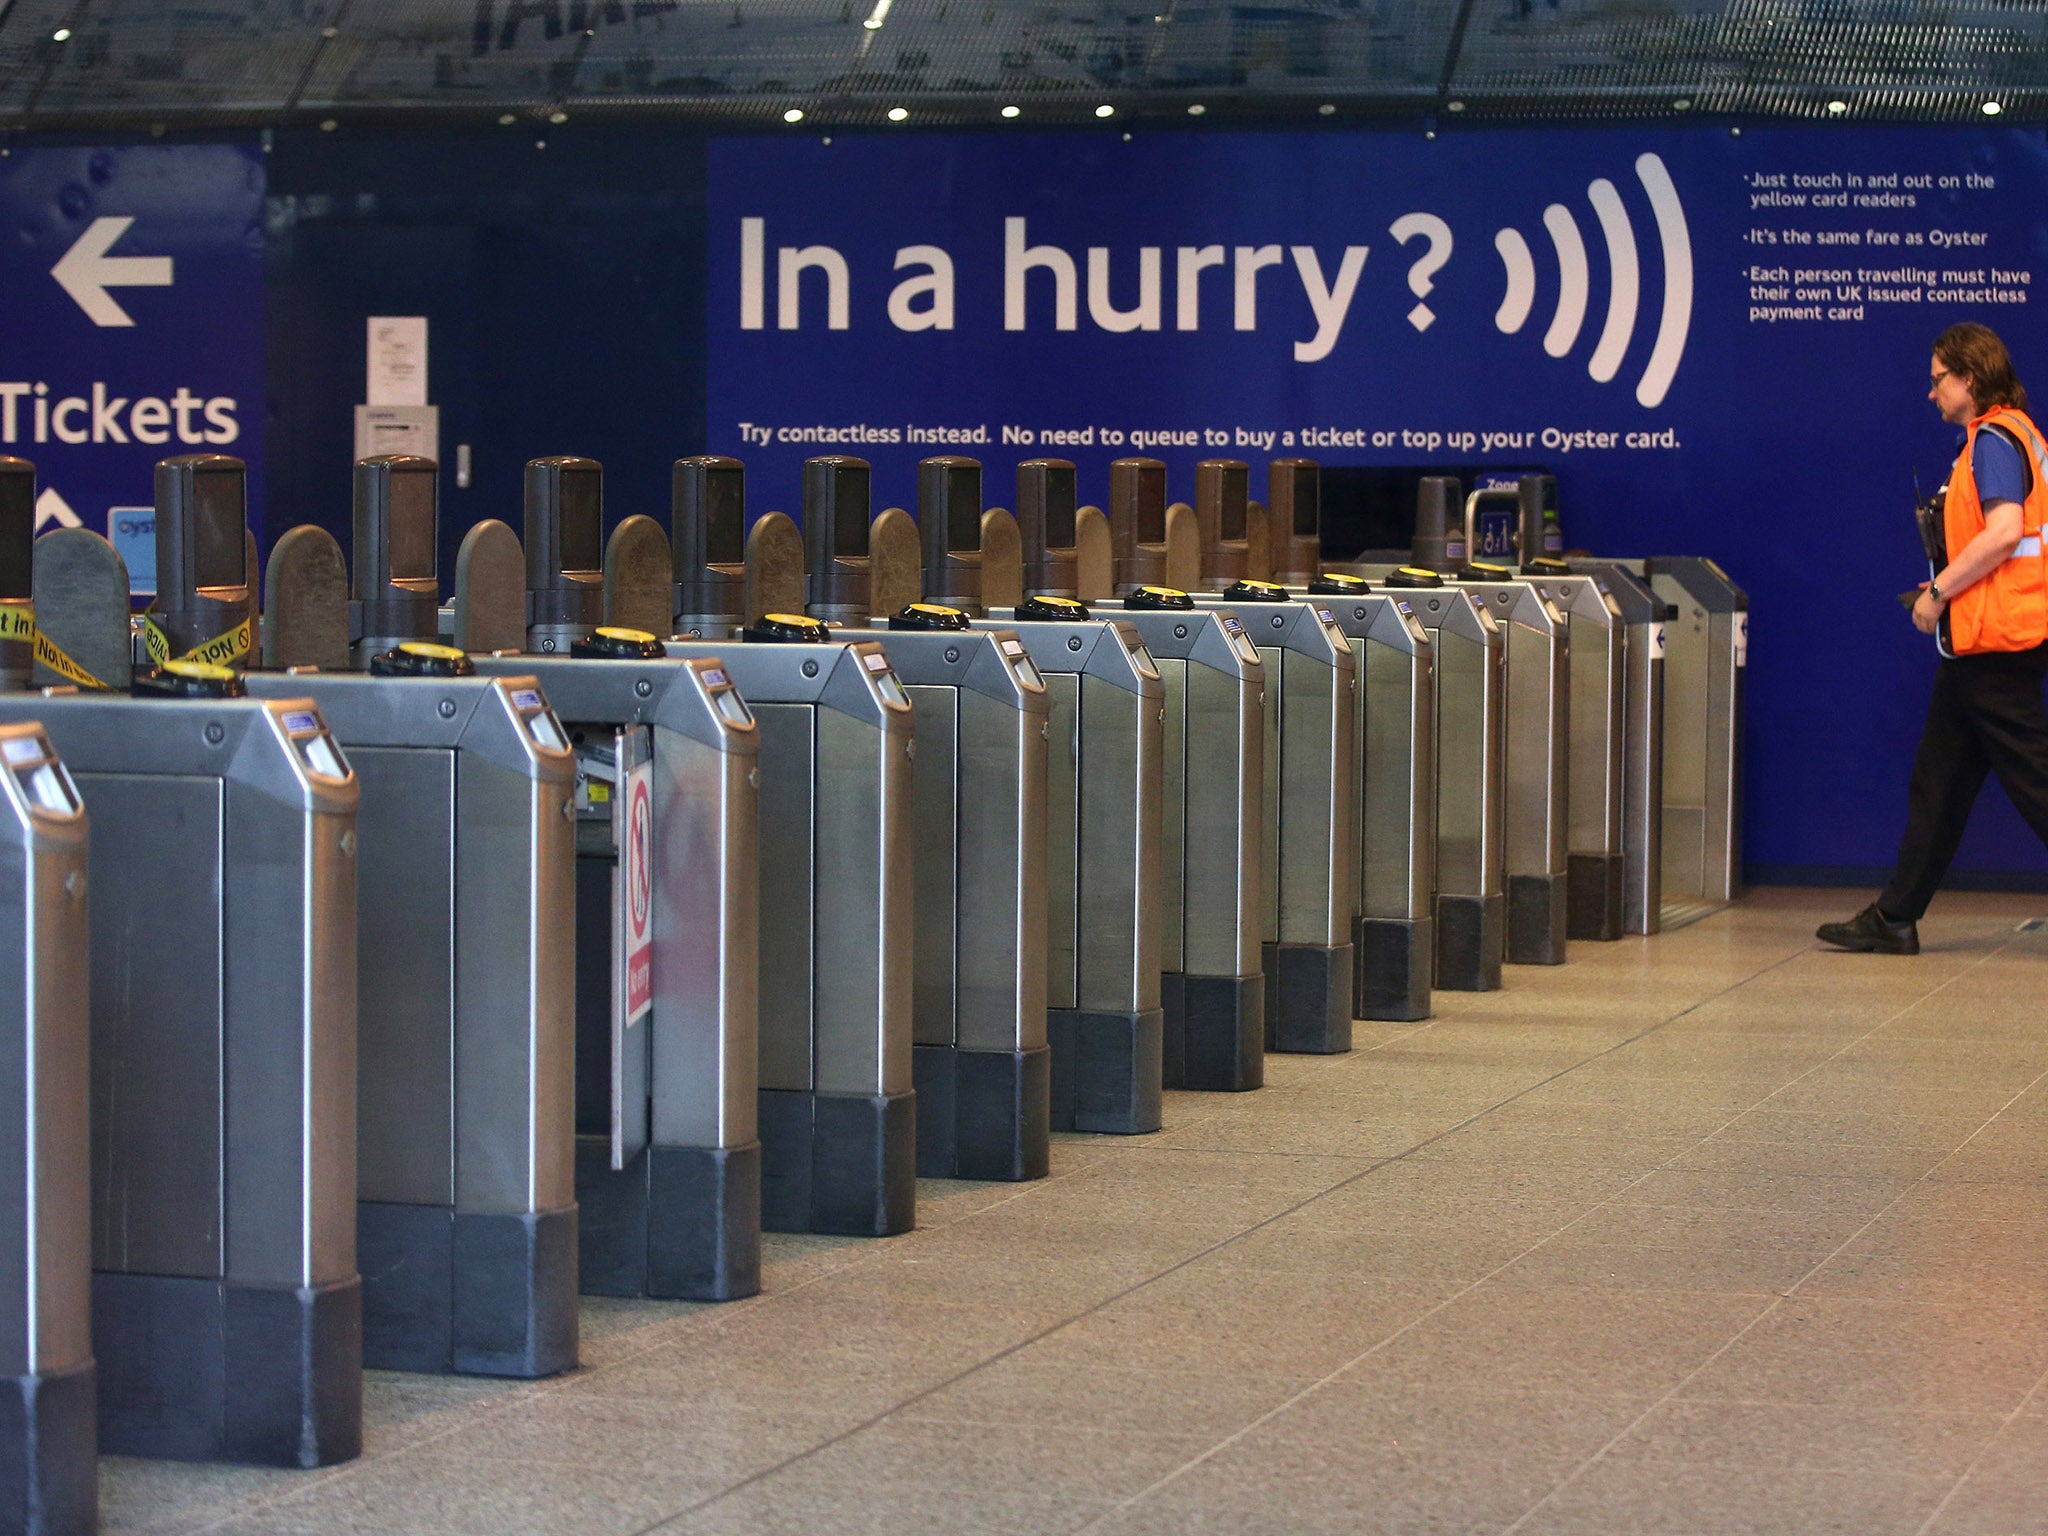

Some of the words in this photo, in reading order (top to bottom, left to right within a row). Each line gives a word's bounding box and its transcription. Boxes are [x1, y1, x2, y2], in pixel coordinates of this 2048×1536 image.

[1751, 172, 1786, 188] Just
[1793, 172, 1842, 188] touch
[1847, 173, 1863, 187] in
[1867, 173, 1898, 188] and
[1903, 174, 1932, 188] out
[1938, 176, 1960, 188] on
[1965, 173, 1995, 188] the
[1750, 191, 1807, 209] yellow
[1811, 191, 1848, 207] card
[1853, 191, 1916, 207] readers
[1751, 228, 1778, 244] It's
[1782, 228, 1812, 245] the
[1816, 231, 1861, 245] same
[1866, 228, 1900, 245] fare
[1905, 232, 1924, 245] as
[1928, 229, 1988, 249] Oyster
[740, 217, 850, 330] In
[887, 245, 955, 332] a
[1750, 265, 1790, 282] Each
[1794, 269, 1853, 286] person
[1857, 267, 1937, 286] travelling
[1942, 269, 1986, 284] must
[1991, 267, 2031, 284] have
[1750, 284, 1790, 301] their
[1795, 288, 1832, 301] own
[1836, 286, 1862, 302] UK
[1867, 285, 1922, 302] issued
[1926, 284, 2027, 303] contactless
[1749, 305, 1823, 323] payment
[1827, 304, 1865, 321] card
[0, 381, 239, 445] Tickets
[738, 422, 773, 447] Try
[777, 423, 901, 444] contactless
[906, 424, 992, 444] instead.
[1002, 425, 1035, 446] No
[1040, 425, 1094, 446] need
[1098, 427, 1125, 446] to
[1129, 430, 1200, 450] queue
[1203, 427, 1230, 447] to
[1235, 426, 1277, 451] buy
[1281, 430, 1295, 447] a
[1300, 426, 1366, 447] ticket
[1371, 431, 1397, 448] or
[1401, 428, 1442, 452] top
[1447, 431, 1477, 453] up
[1481, 432, 1536, 453] your
[1541, 427, 1620, 453] Oyster
[1624, 427, 1681, 449] card.
[1486, 478, 1520, 490] Zone
[38, 637, 60, 667] Not
[201, 637, 235, 665] Not
